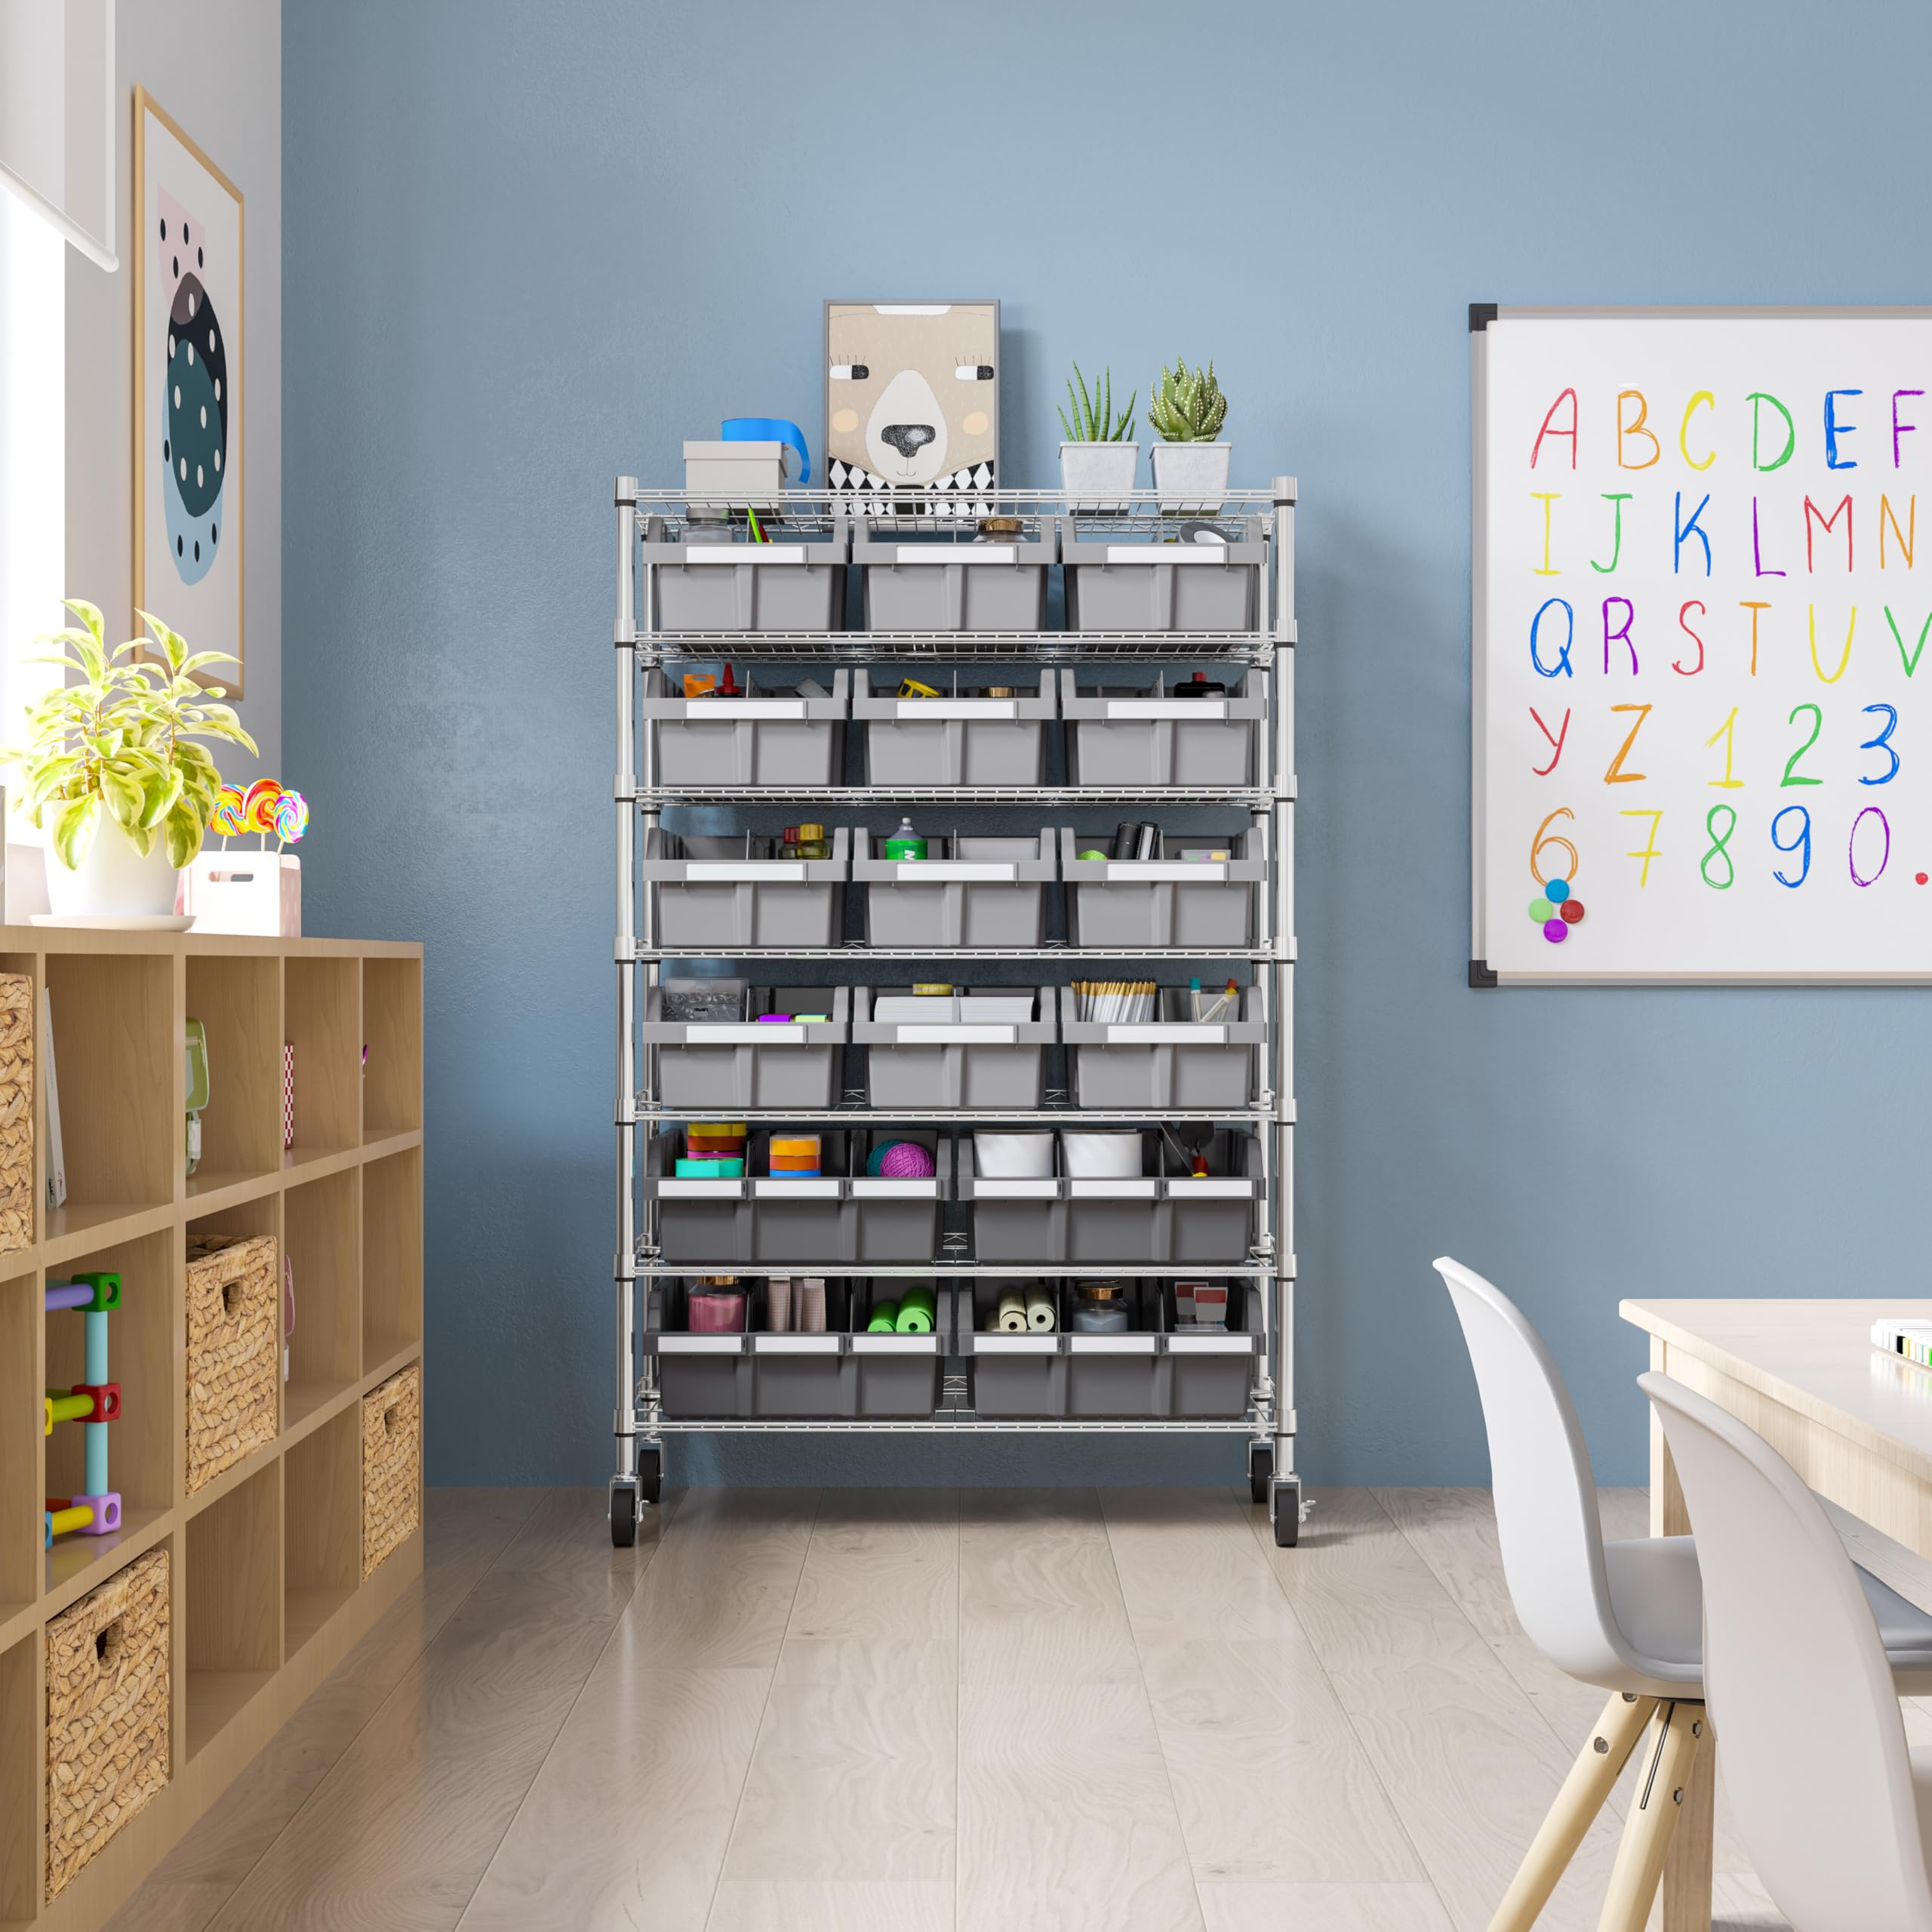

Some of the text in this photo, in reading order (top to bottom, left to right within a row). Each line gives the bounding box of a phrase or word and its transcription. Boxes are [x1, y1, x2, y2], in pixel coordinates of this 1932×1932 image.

[1531, 388, 1925, 471] A B C D E F
[1531, 491, 1915, 577] I J K L M N
[1530, 596, 1932, 684] Q R S T U V
[1604, 703, 1653, 785] Z
[1703, 706, 1745, 789] 1
[1780, 703, 1823, 787] 2
[1859, 703, 1900, 786] 3
[1531, 807, 1578, 887] 6
[1619, 810, 1663, 888] 7
[1701, 804, 1736, 889] 8
[1771, 805, 1811, 889] 9
[1849, 807, 1890, 888] 0
